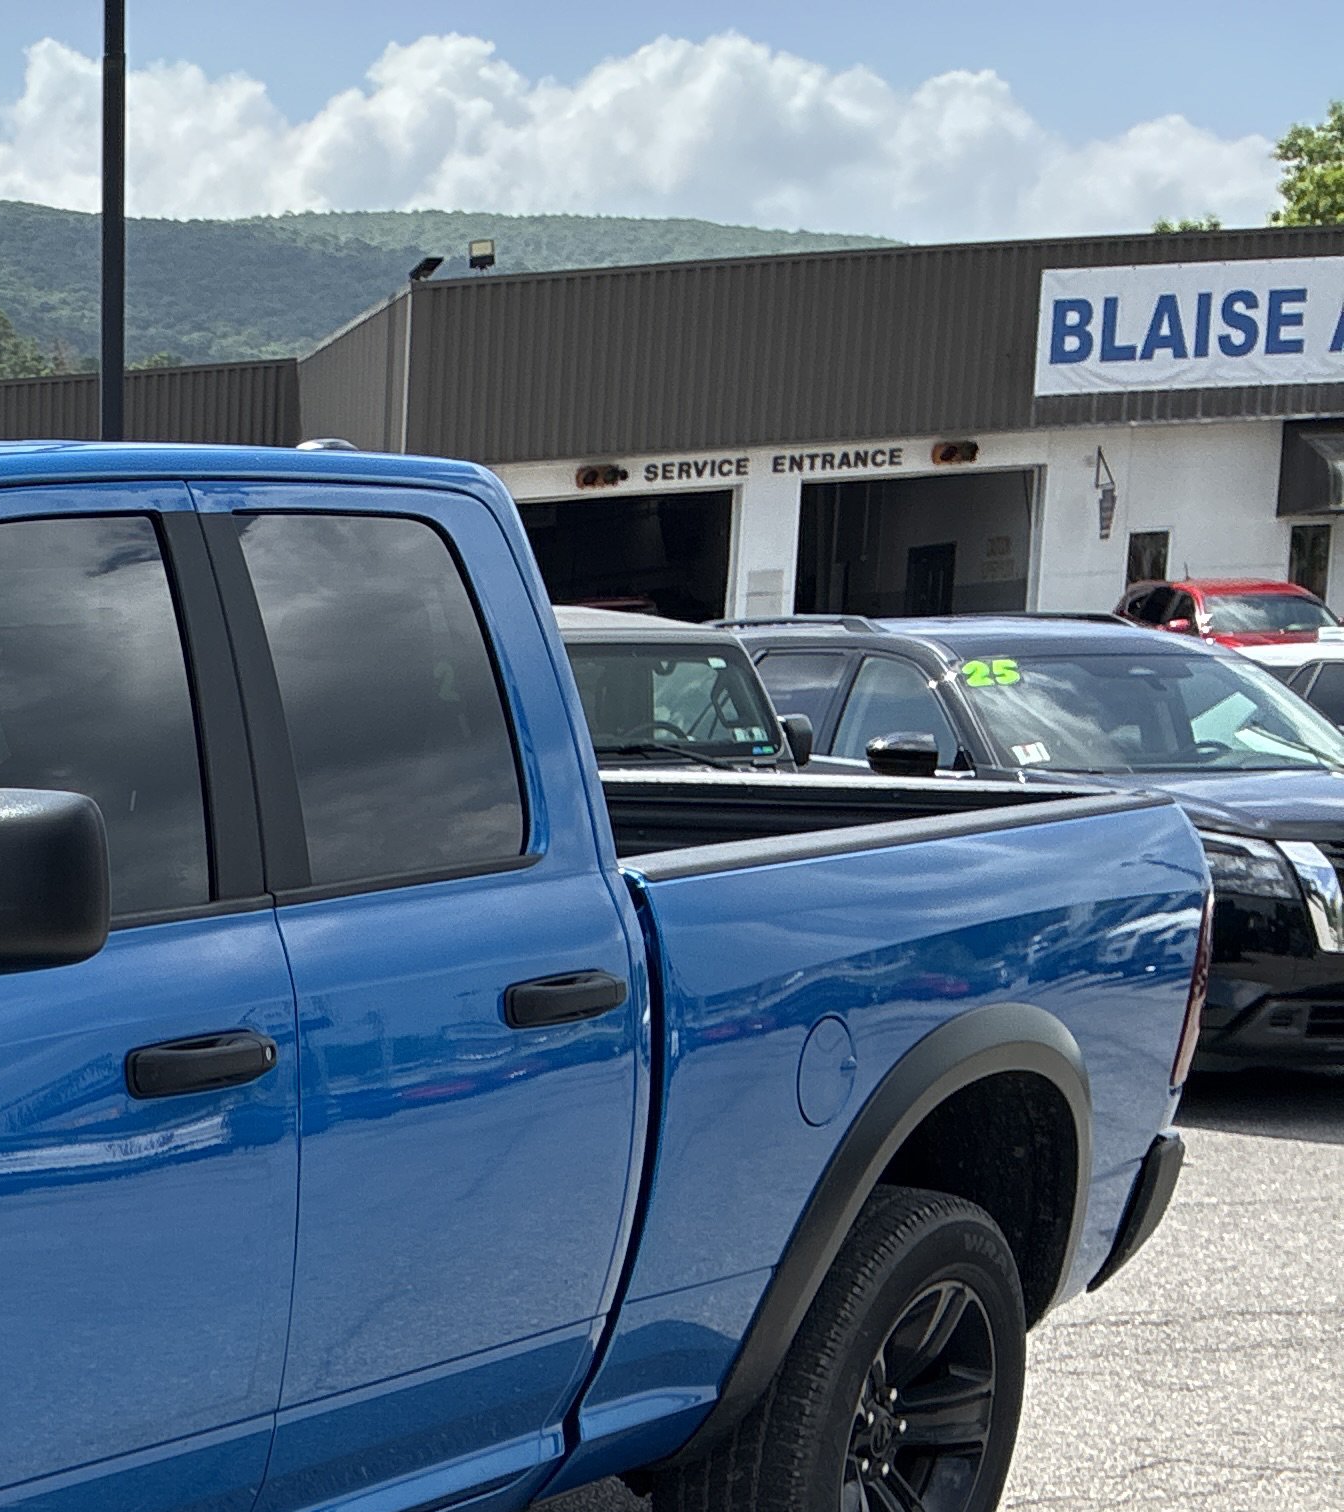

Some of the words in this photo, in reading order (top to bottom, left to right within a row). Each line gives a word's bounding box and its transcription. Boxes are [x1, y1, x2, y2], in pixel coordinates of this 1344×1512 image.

[1049, 287, 1308, 365] BLAISE
[643, 458, 750, 482] SERVICE
[771, 448, 904, 473] ENTRANCE
[961, 659, 1021, 687] 25
